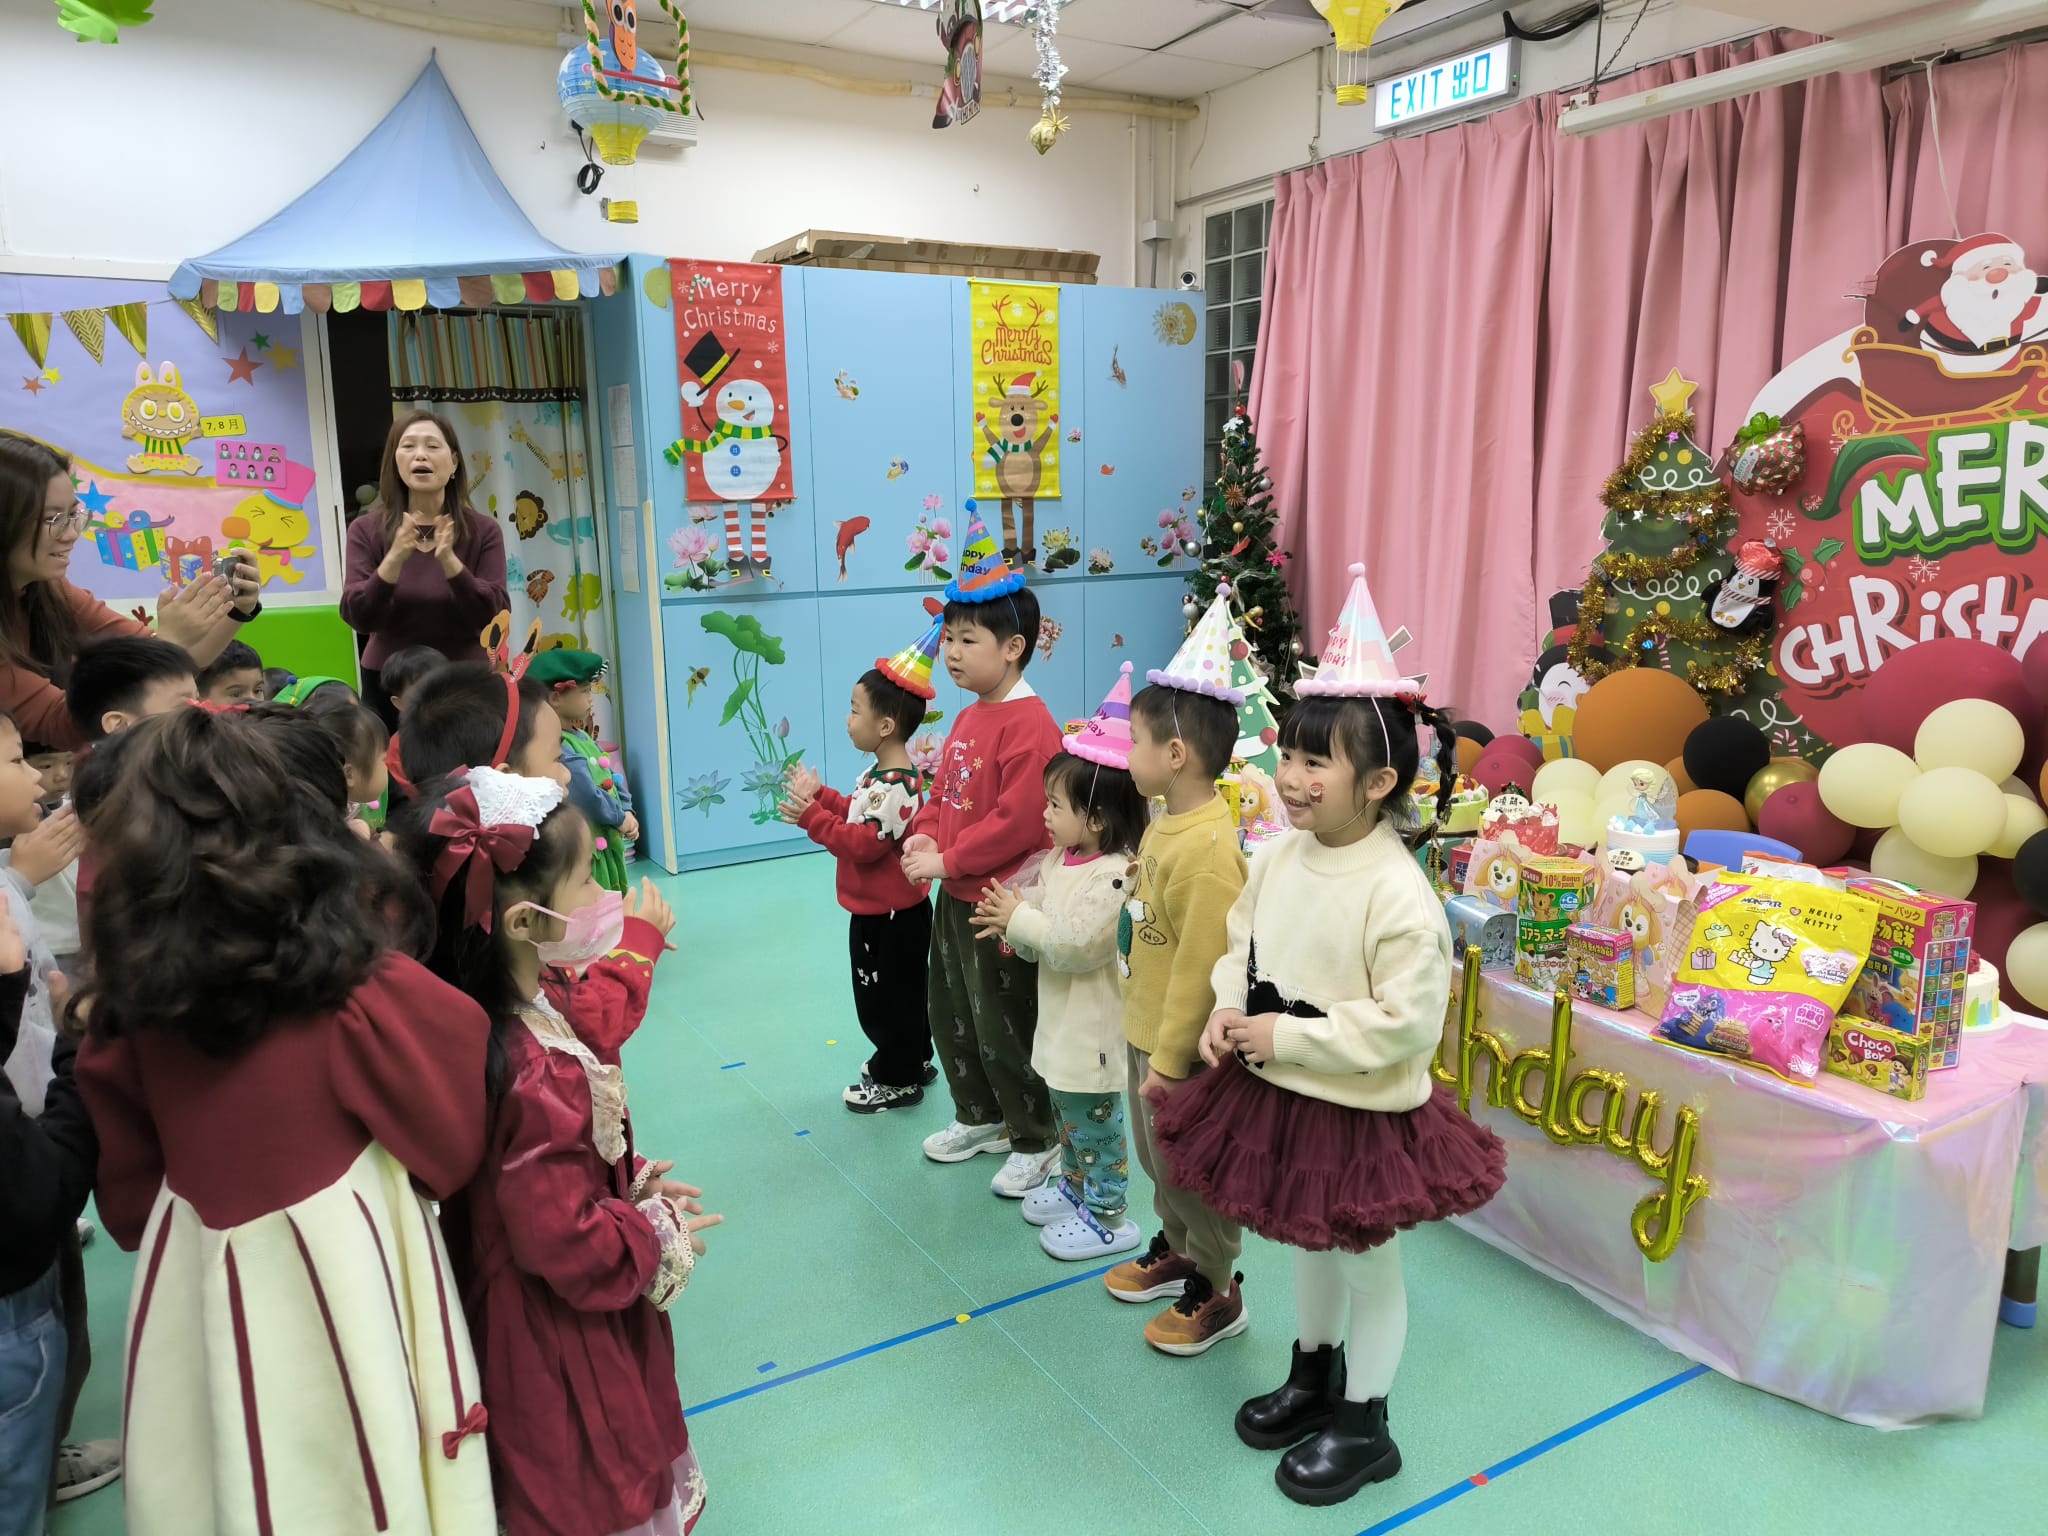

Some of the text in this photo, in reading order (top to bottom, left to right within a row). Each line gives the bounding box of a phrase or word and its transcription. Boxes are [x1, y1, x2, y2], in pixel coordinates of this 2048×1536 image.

[1391, 53, 1491, 120] EXIT 出口
[688, 274, 762, 304] Merry
[684, 306, 777, 333] Christmas
[995, 326, 1042, 351] Merry
[982, 339, 1053, 366] Christmas
[1545, 875, 1561, 888] 10%
[1803, 917, 1839, 932] KITTY
[1808, 907, 1843, 921] HELLO
[1143, 932, 1160, 943] No
[1847, 1032, 1892, 1053] Choco
